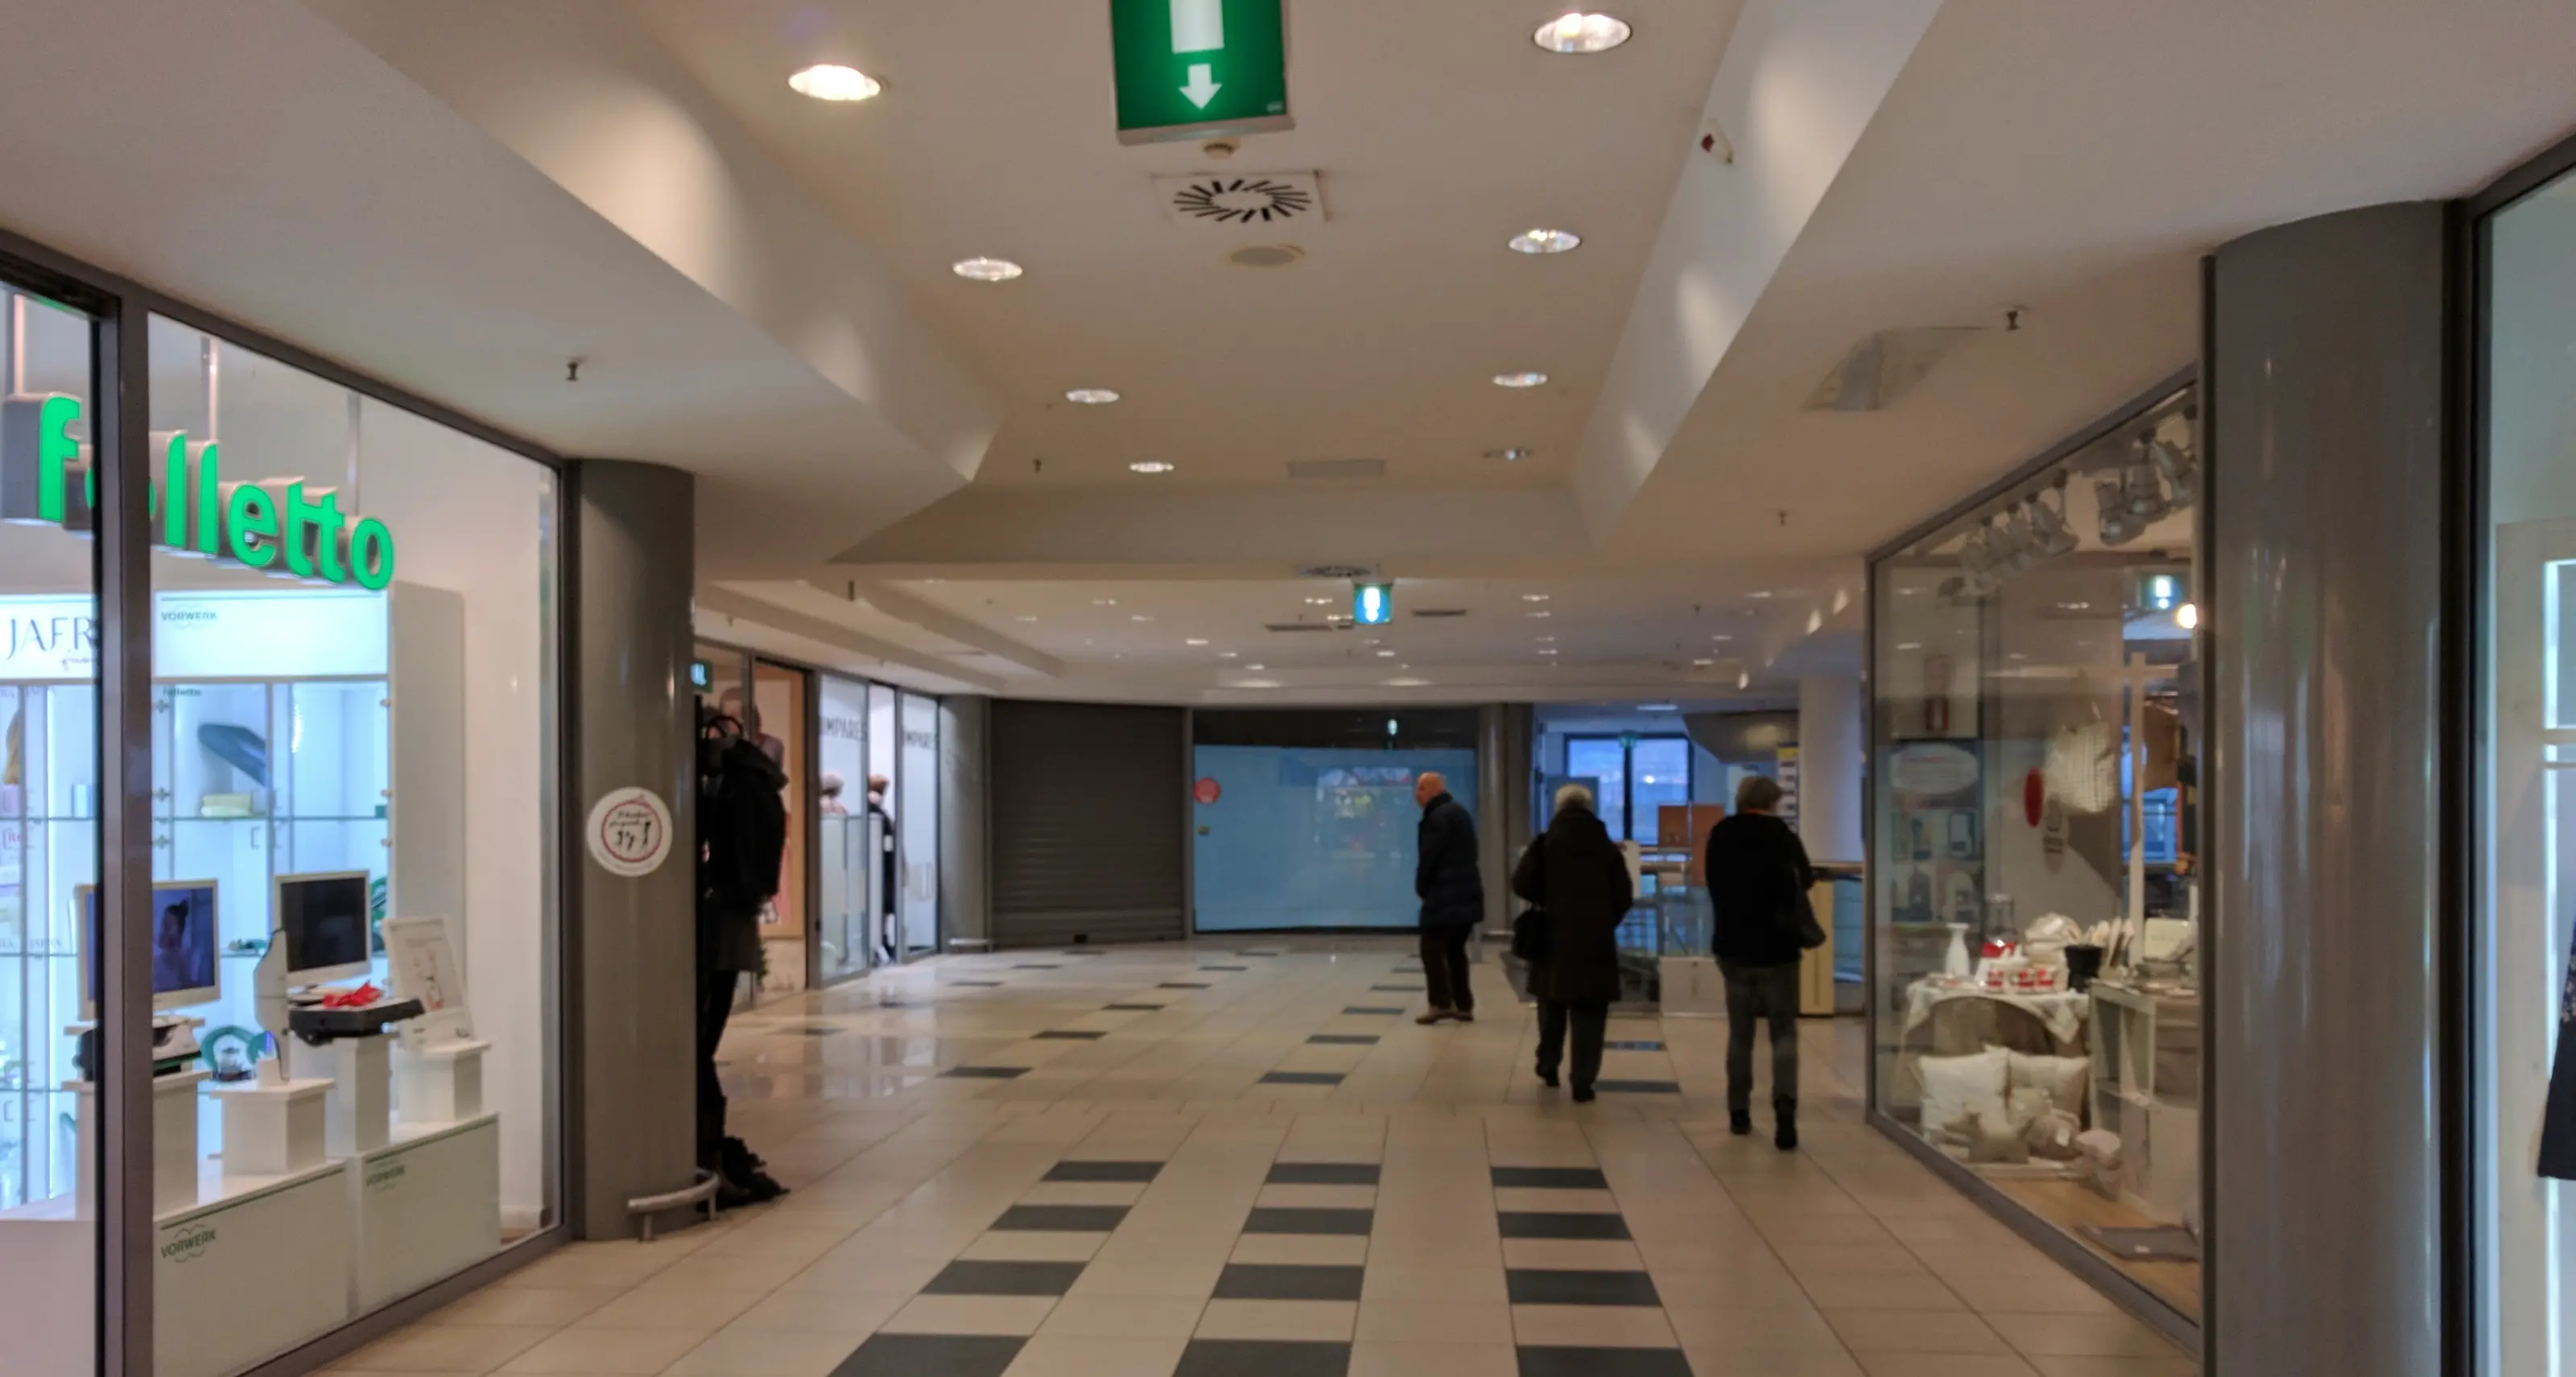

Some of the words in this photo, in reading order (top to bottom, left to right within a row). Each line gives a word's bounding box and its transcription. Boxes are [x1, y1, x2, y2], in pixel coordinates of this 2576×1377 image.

[39, 395, 394, 591] flletto
[161, 611, 218, 622] VORWERK
[6, 616, 100, 661] JAFR
[161, 1230, 216, 1258] VORWERK
